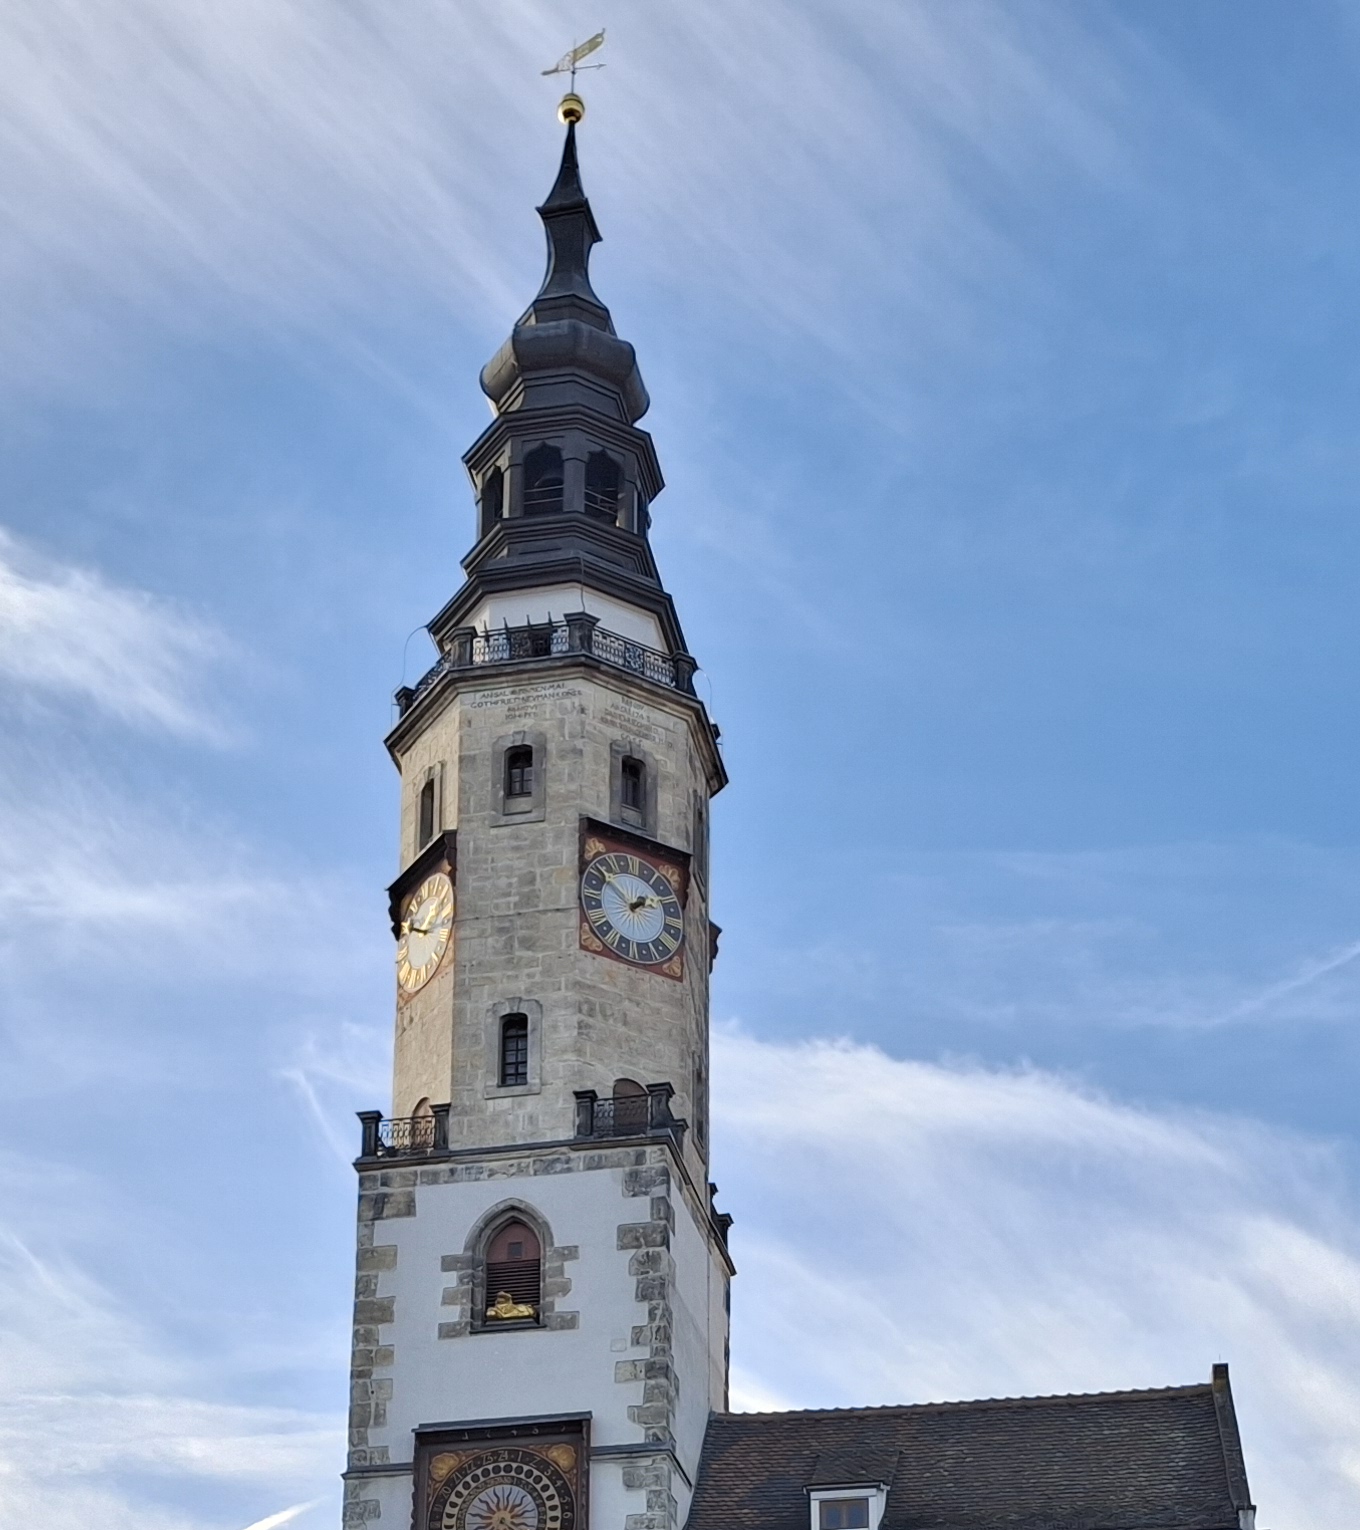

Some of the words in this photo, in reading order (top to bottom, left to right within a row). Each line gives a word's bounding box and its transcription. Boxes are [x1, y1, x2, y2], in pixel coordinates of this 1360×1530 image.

[498, 1451, 509, 1462] 24
[517, 1452, 522, 1462] 1
[563, 1511, 573, 1519] 6
